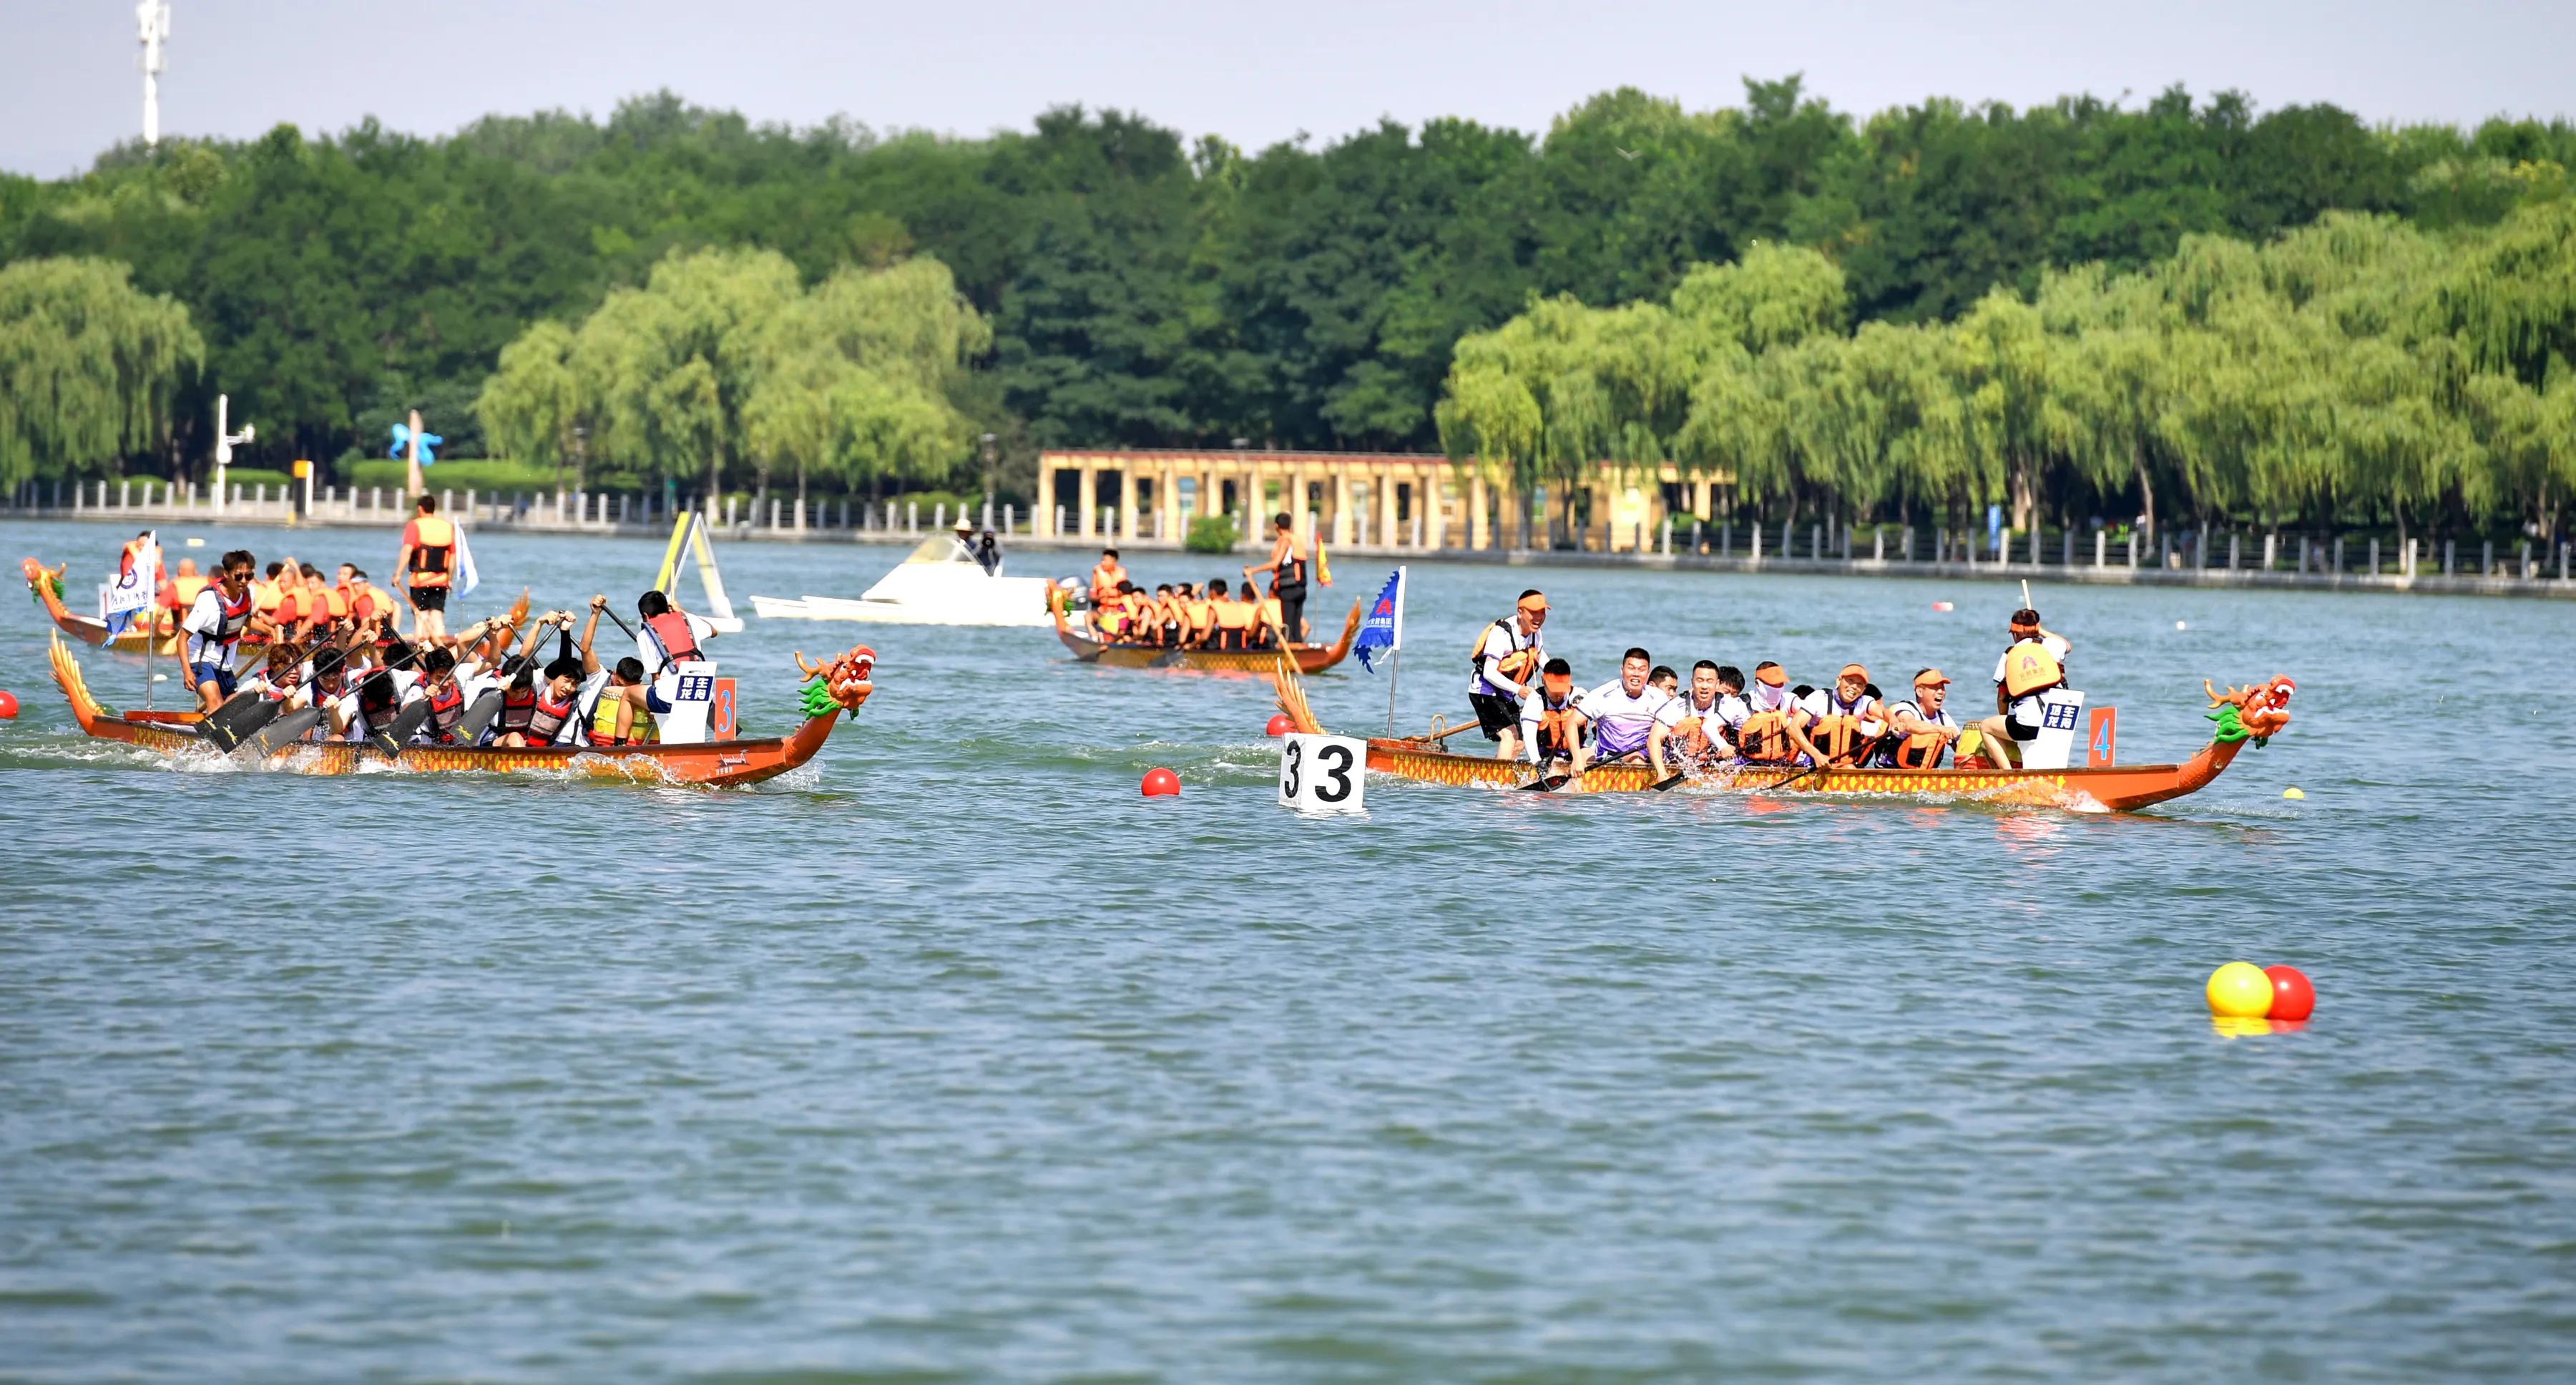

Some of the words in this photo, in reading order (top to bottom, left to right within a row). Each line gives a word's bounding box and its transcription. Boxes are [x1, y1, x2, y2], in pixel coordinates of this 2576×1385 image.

[719, 689, 732, 733] 3
[2093, 718, 2111, 760] 4
[1284, 740, 1301, 798] 3
[1315, 745, 1353, 803] 3
